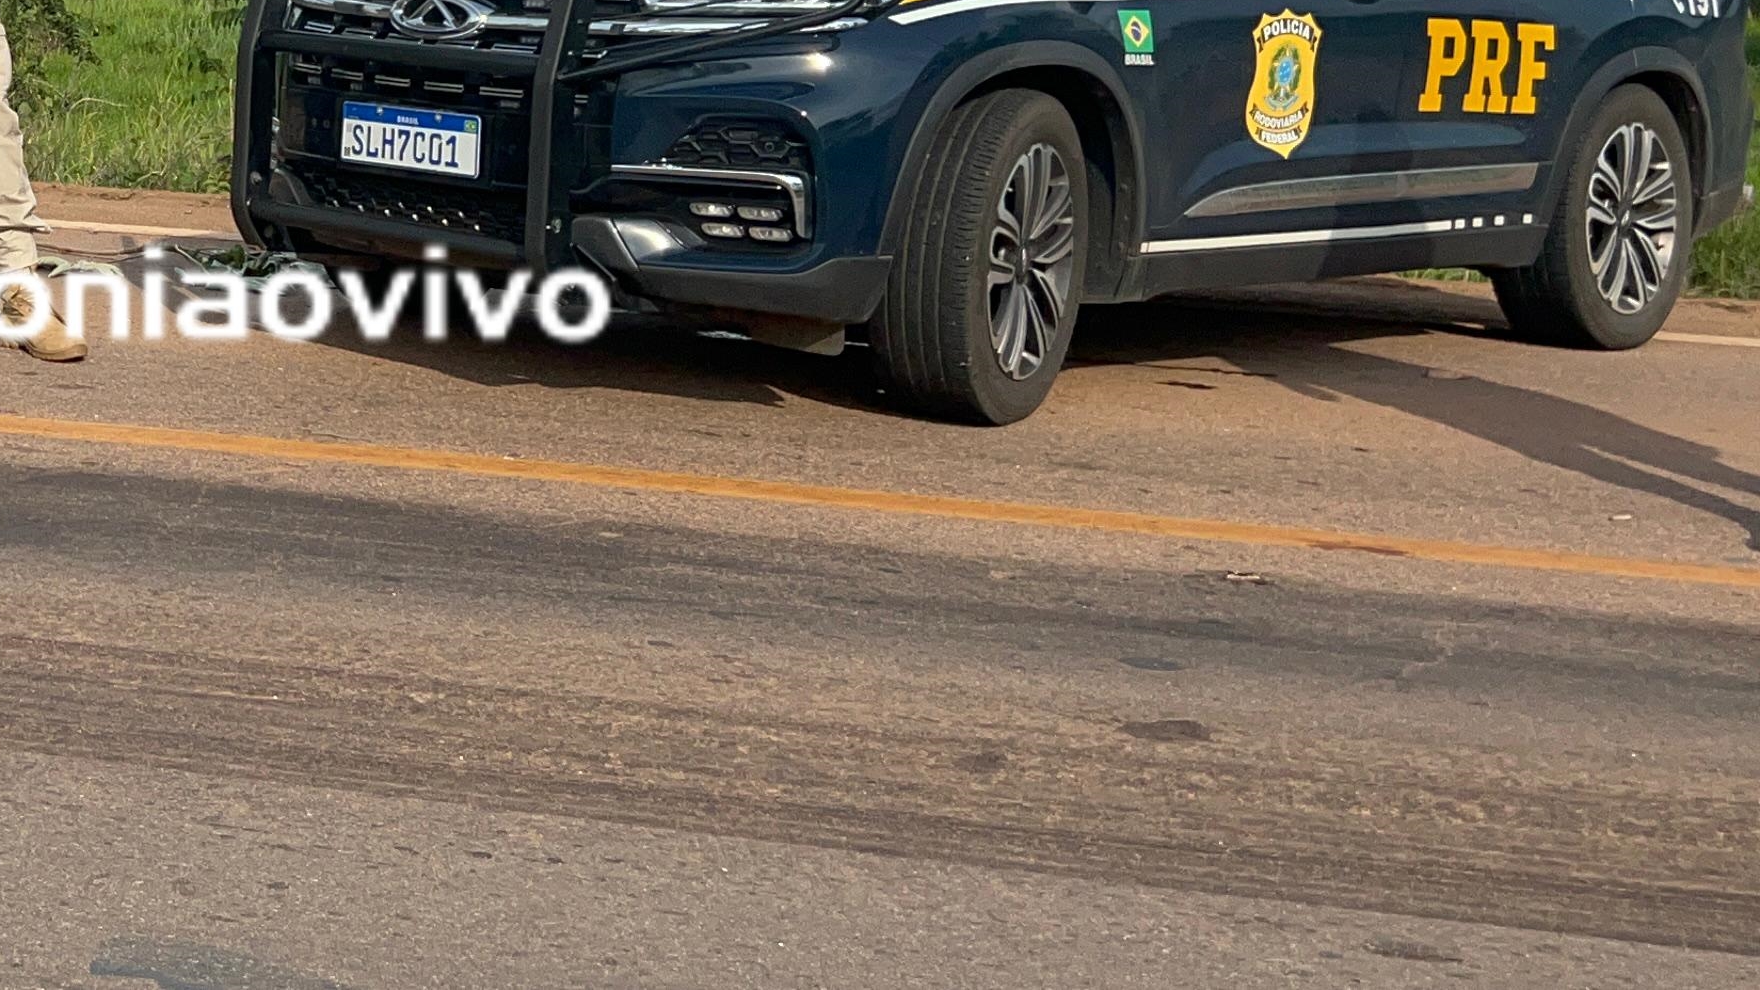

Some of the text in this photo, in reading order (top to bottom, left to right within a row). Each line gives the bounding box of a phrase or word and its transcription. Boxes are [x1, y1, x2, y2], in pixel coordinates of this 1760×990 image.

[1418, 18, 1555, 114] PRF
[397, 115, 419, 125] BRASIL
[351, 124, 459, 168] SLH7C01
[1260, 129, 1298, 144] FEDERAL
